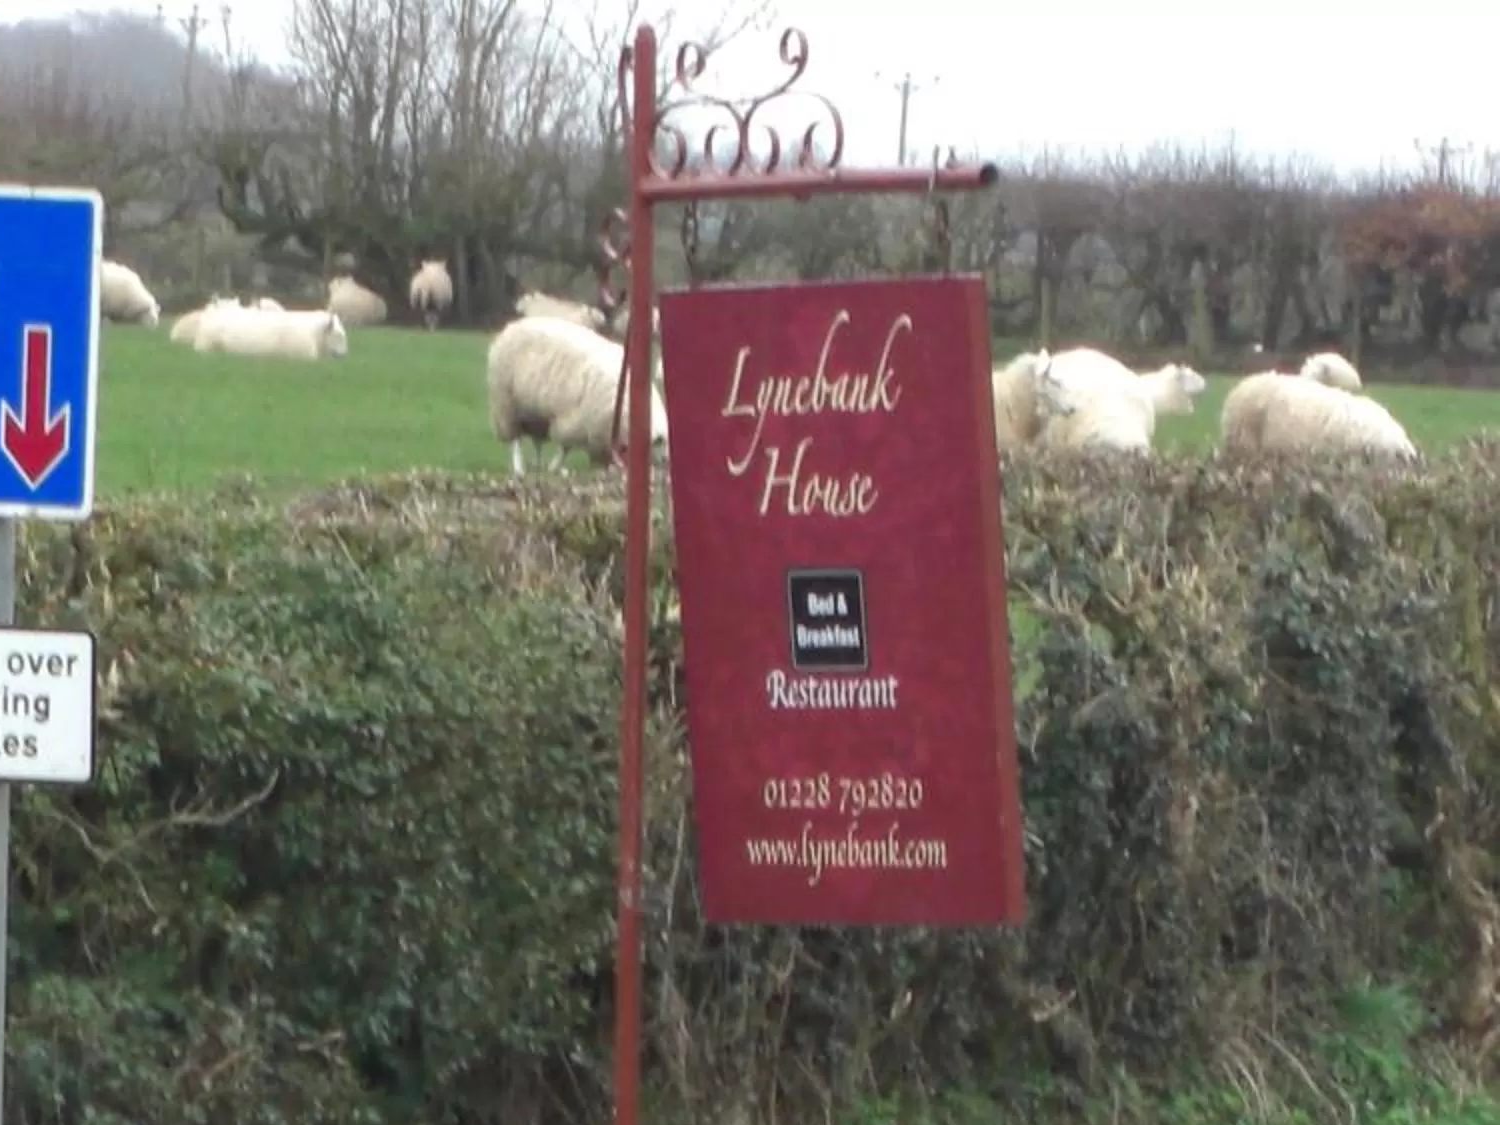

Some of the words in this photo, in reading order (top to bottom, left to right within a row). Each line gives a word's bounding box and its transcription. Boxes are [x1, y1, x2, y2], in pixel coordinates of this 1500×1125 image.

[721, 310, 913, 476] Lynebank
[759, 437, 879, 517] House
[806, 592, 835, 616] Bed
[796, 624, 861, 649] Breakfast
[7, 651, 78, 677] over
[766, 669, 898, 710] Restaurant
[763, 772, 831, 808] 01228
[839, 772, 924, 816] 792820
[746, 820, 948, 887] www.lynebank.com
